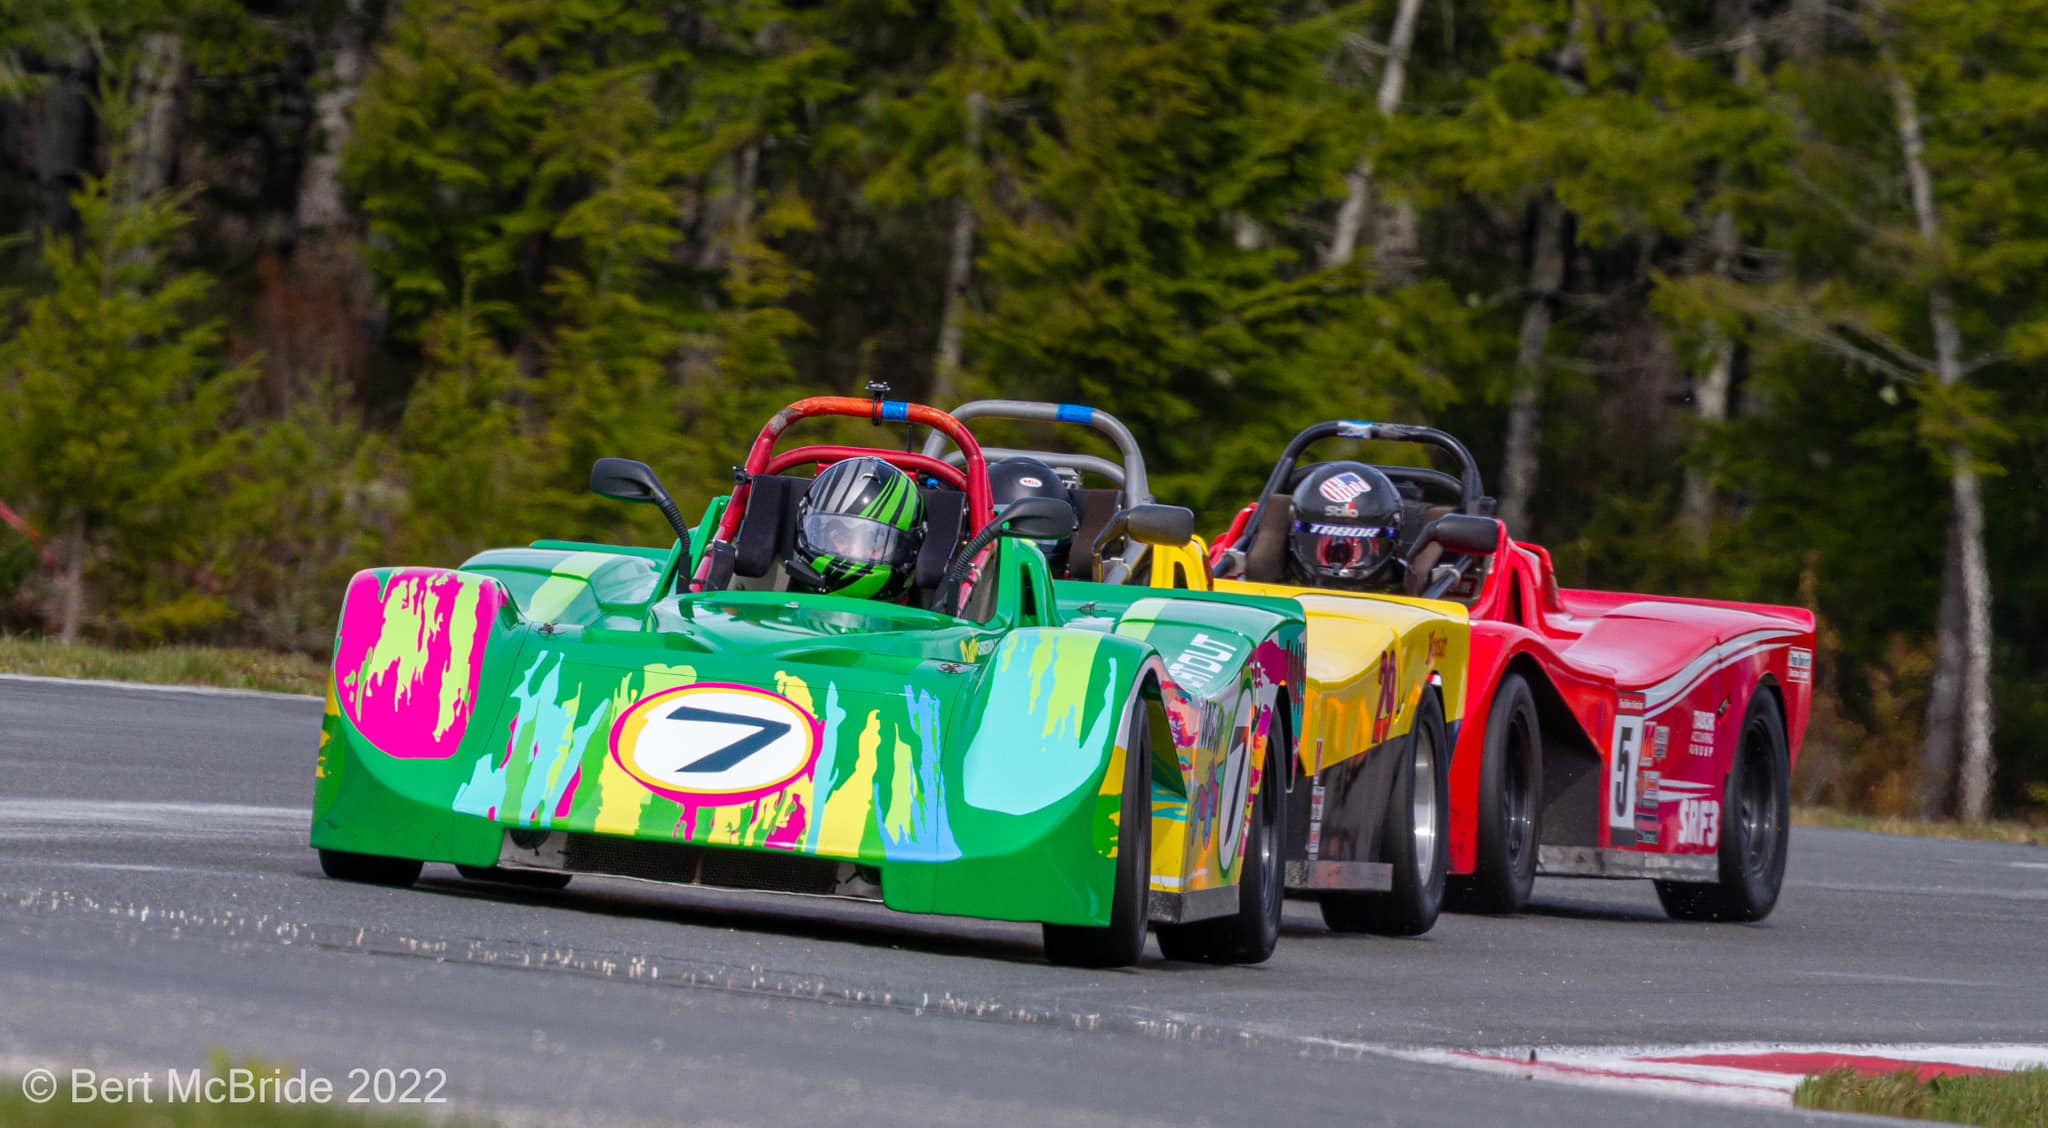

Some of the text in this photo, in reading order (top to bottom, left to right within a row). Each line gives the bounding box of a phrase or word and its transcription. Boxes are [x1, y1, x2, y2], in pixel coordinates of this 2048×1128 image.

[1310, 523, 1380, 537] TABOR
[665, 705, 792, 773] 7
[1615, 726, 1633, 817] 5
[1679, 799, 1719, 847] SRF3
